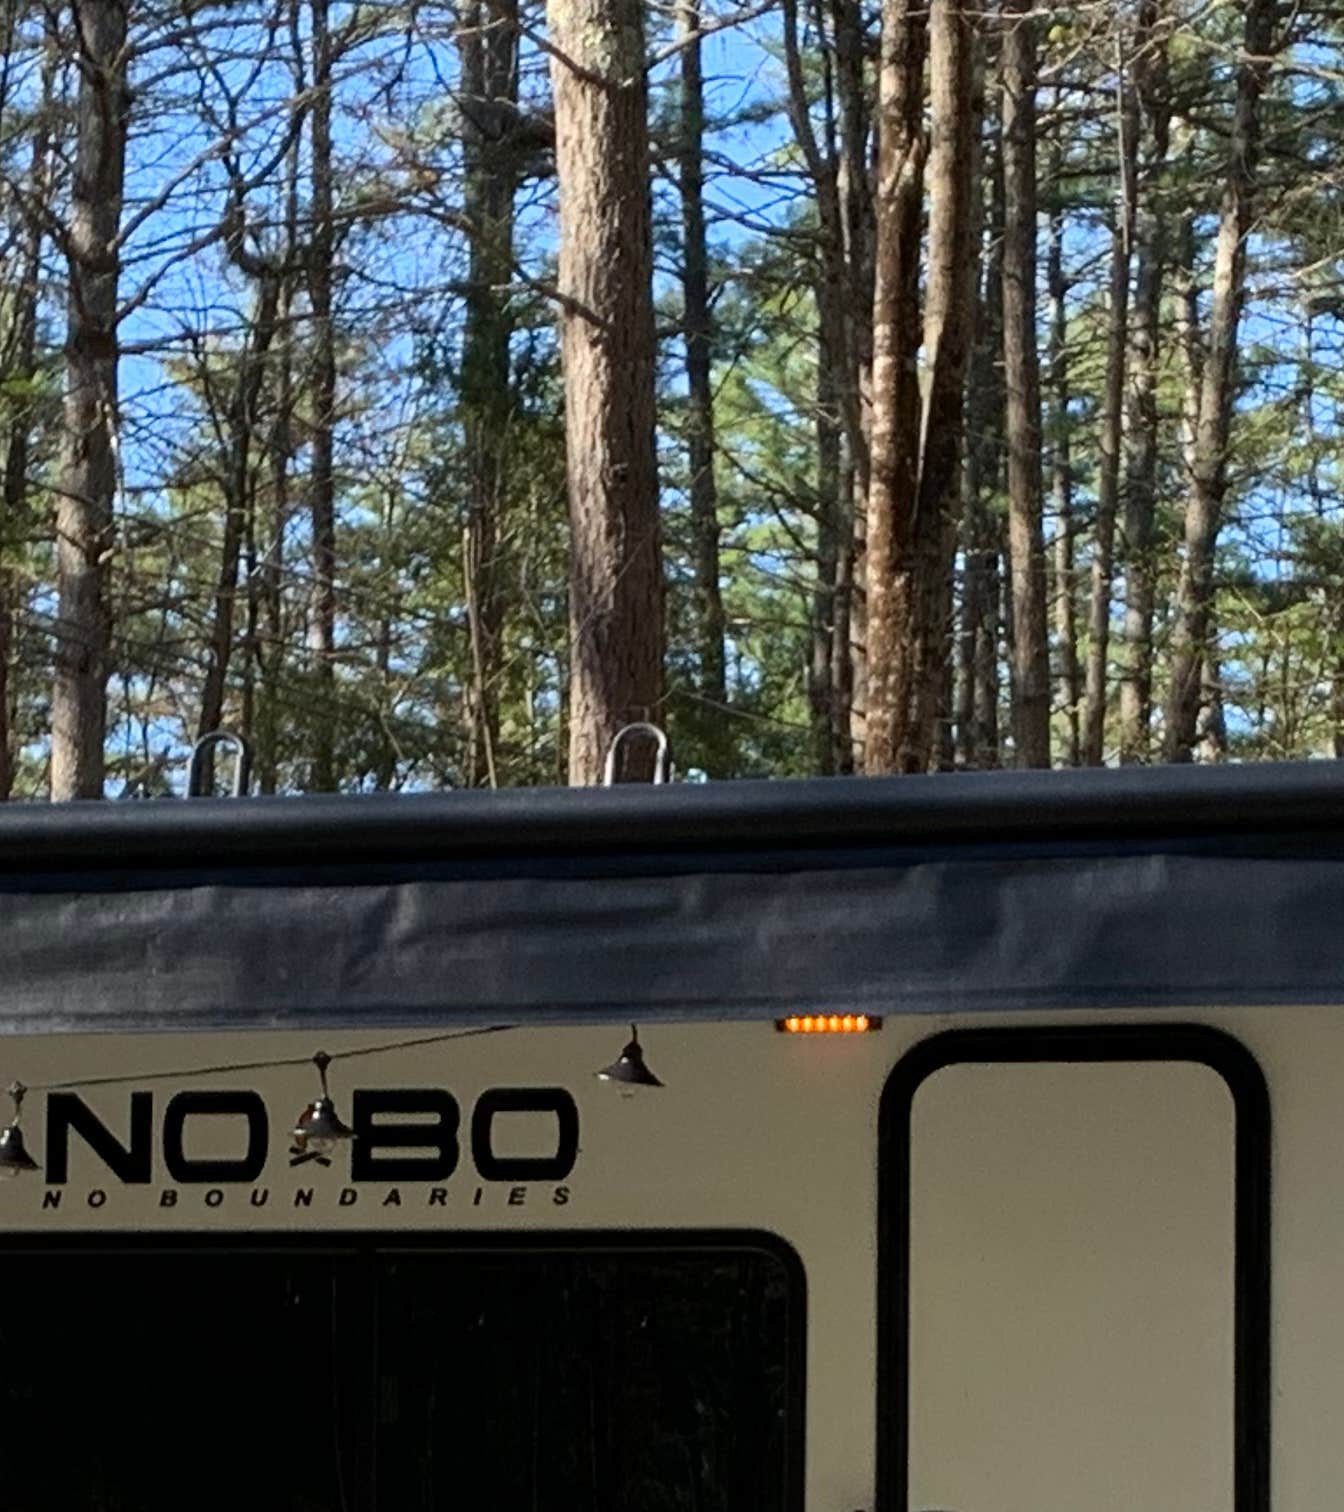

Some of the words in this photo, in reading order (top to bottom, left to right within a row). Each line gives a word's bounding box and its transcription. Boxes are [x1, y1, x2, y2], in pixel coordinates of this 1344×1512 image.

[44, 1091, 268, 1184] NO
[351, 1087, 579, 1182] BO
[42, 1190, 106, 1208] NO
[160, 1187, 570, 1207] BOUNDARIES
